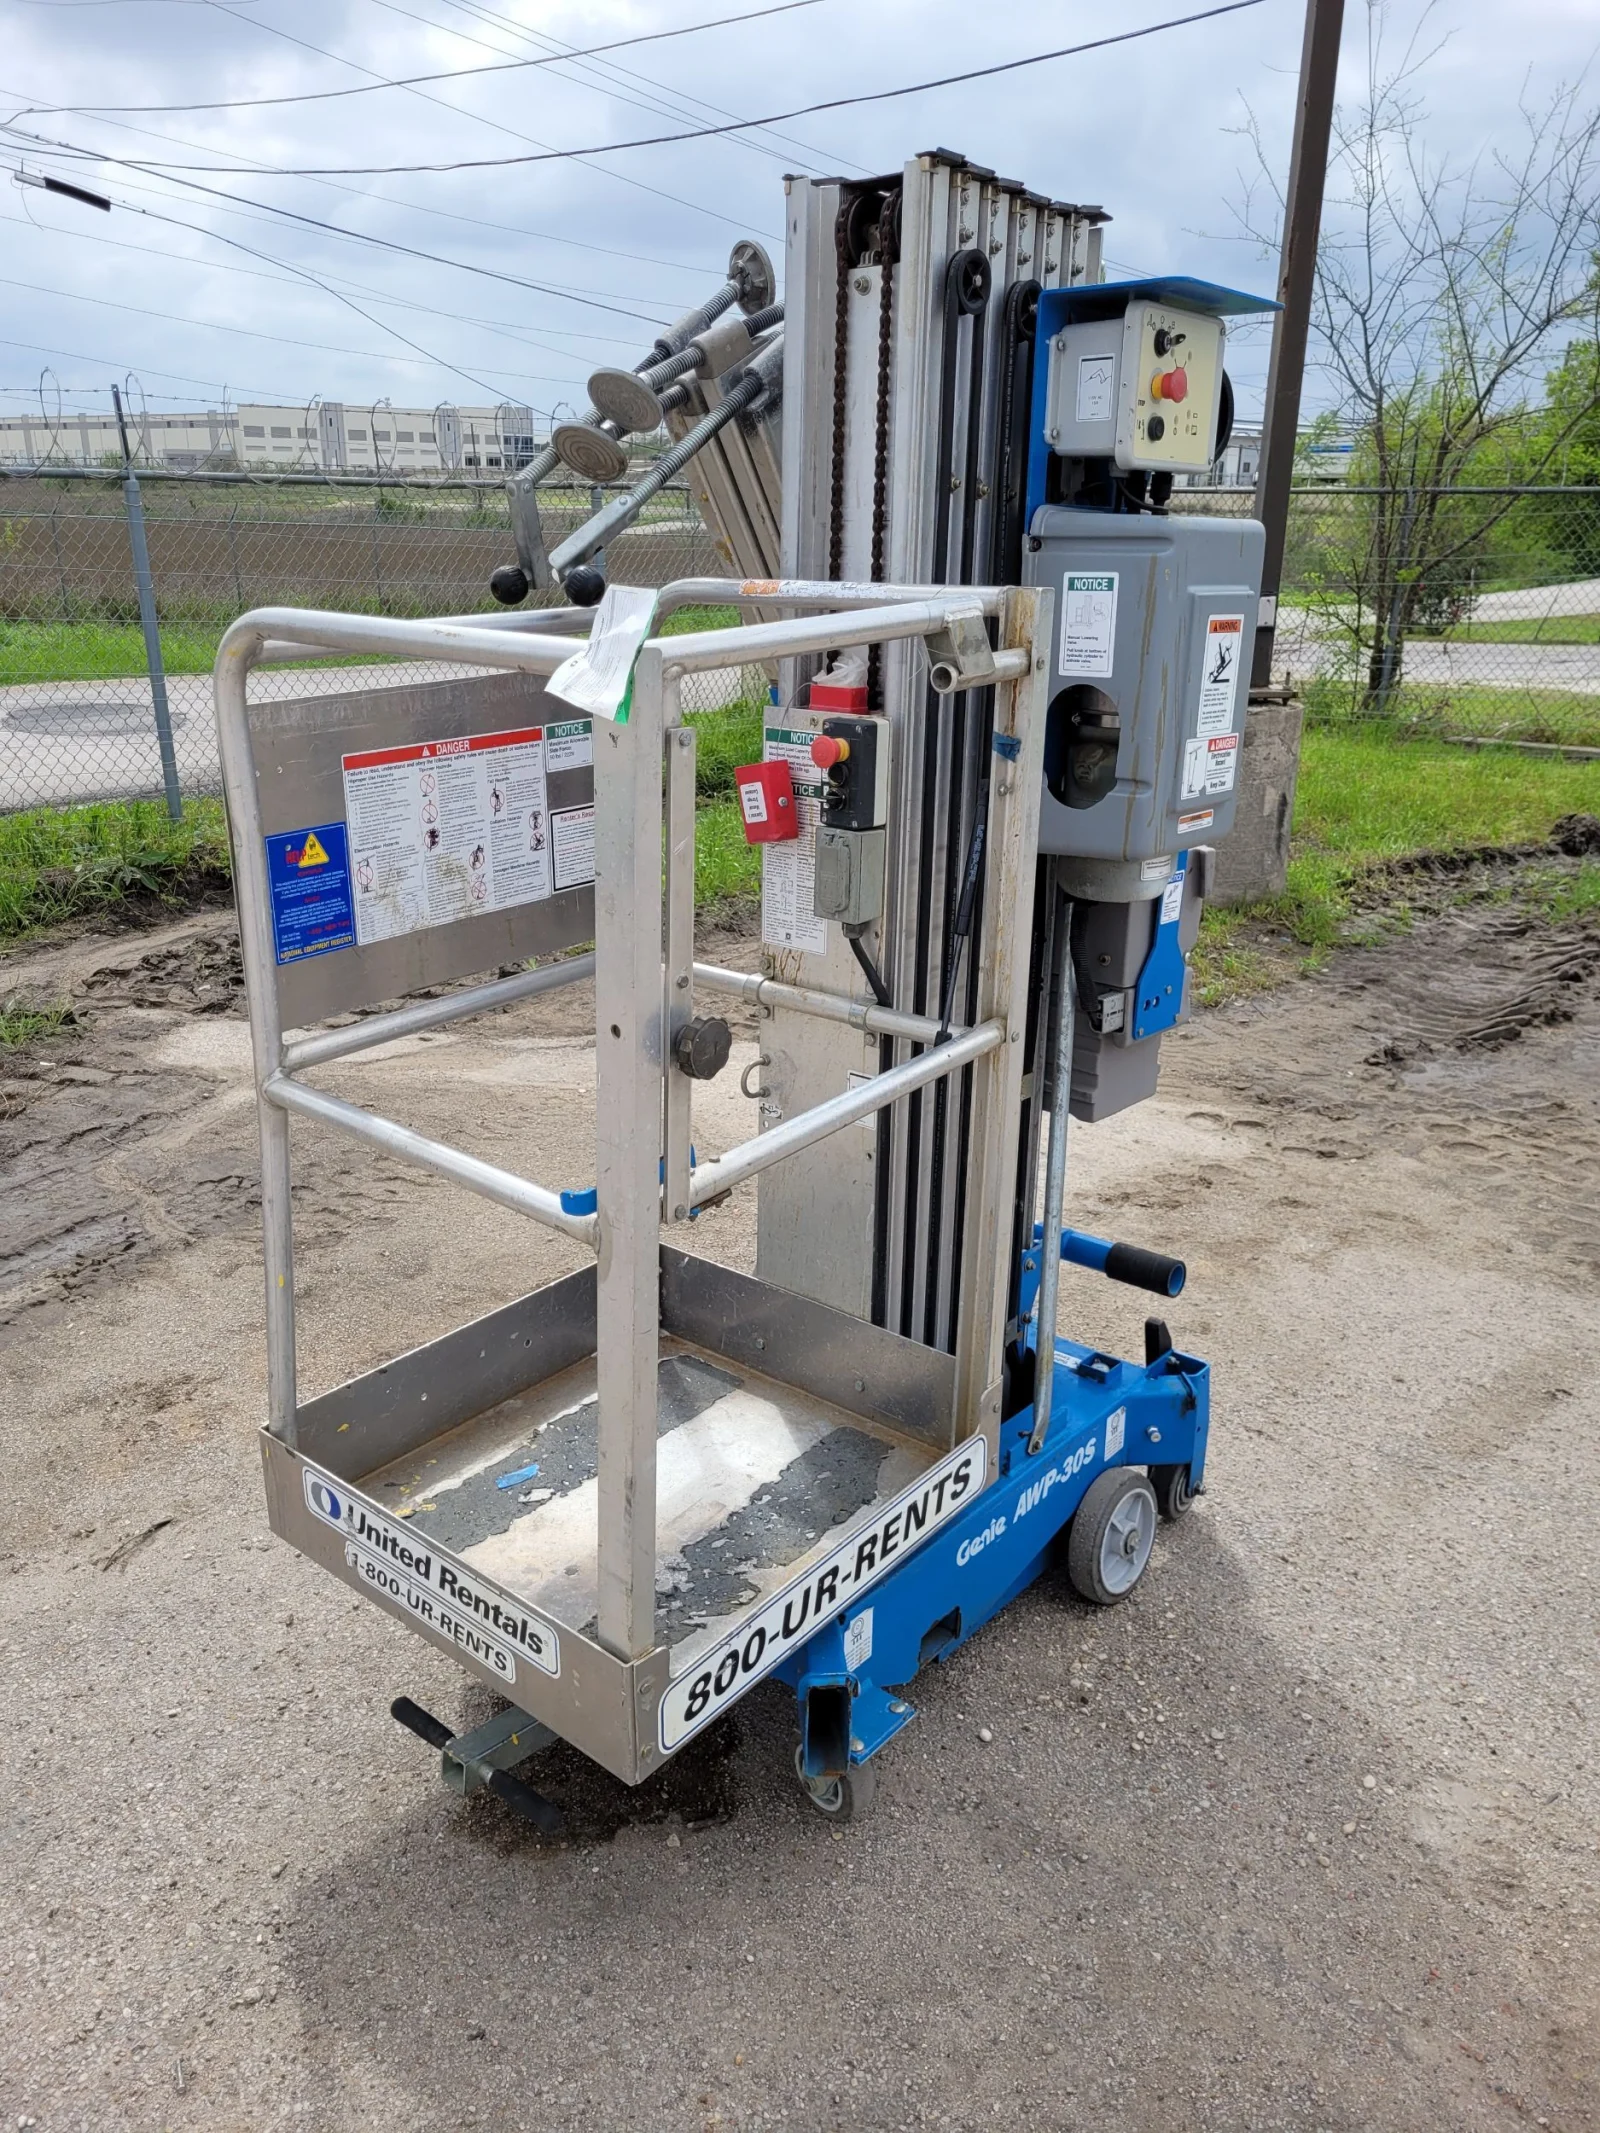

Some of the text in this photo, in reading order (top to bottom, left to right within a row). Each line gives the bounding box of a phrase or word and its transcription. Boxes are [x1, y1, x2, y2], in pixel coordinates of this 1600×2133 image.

[1074, 578, 1108, 590] NOTICE
[1220, 621, 1238, 630] WARNING
[555, 723, 584, 737] NOTICE
[436, 740, 470, 755] DANGER
[1216, 737, 1235, 750] DANGER
[382, 763, 405, 772] understand
[794, 784, 815, 796] TICE
[354, 845, 382, 853] Electrocution
[281, 935, 352, 959] NATIONAL EQUIPMENT REGISTER
[956, 1516, 1007, 1566] Genie
[1013, 1438, 1096, 1524] AWP-30S
[348, 1504, 543, 1656] United Rentals
[684, 1458, 972, 1722] 800-UR-RENTS
[351, 1552, 507, 1672] 1-800-UR-RENTS
